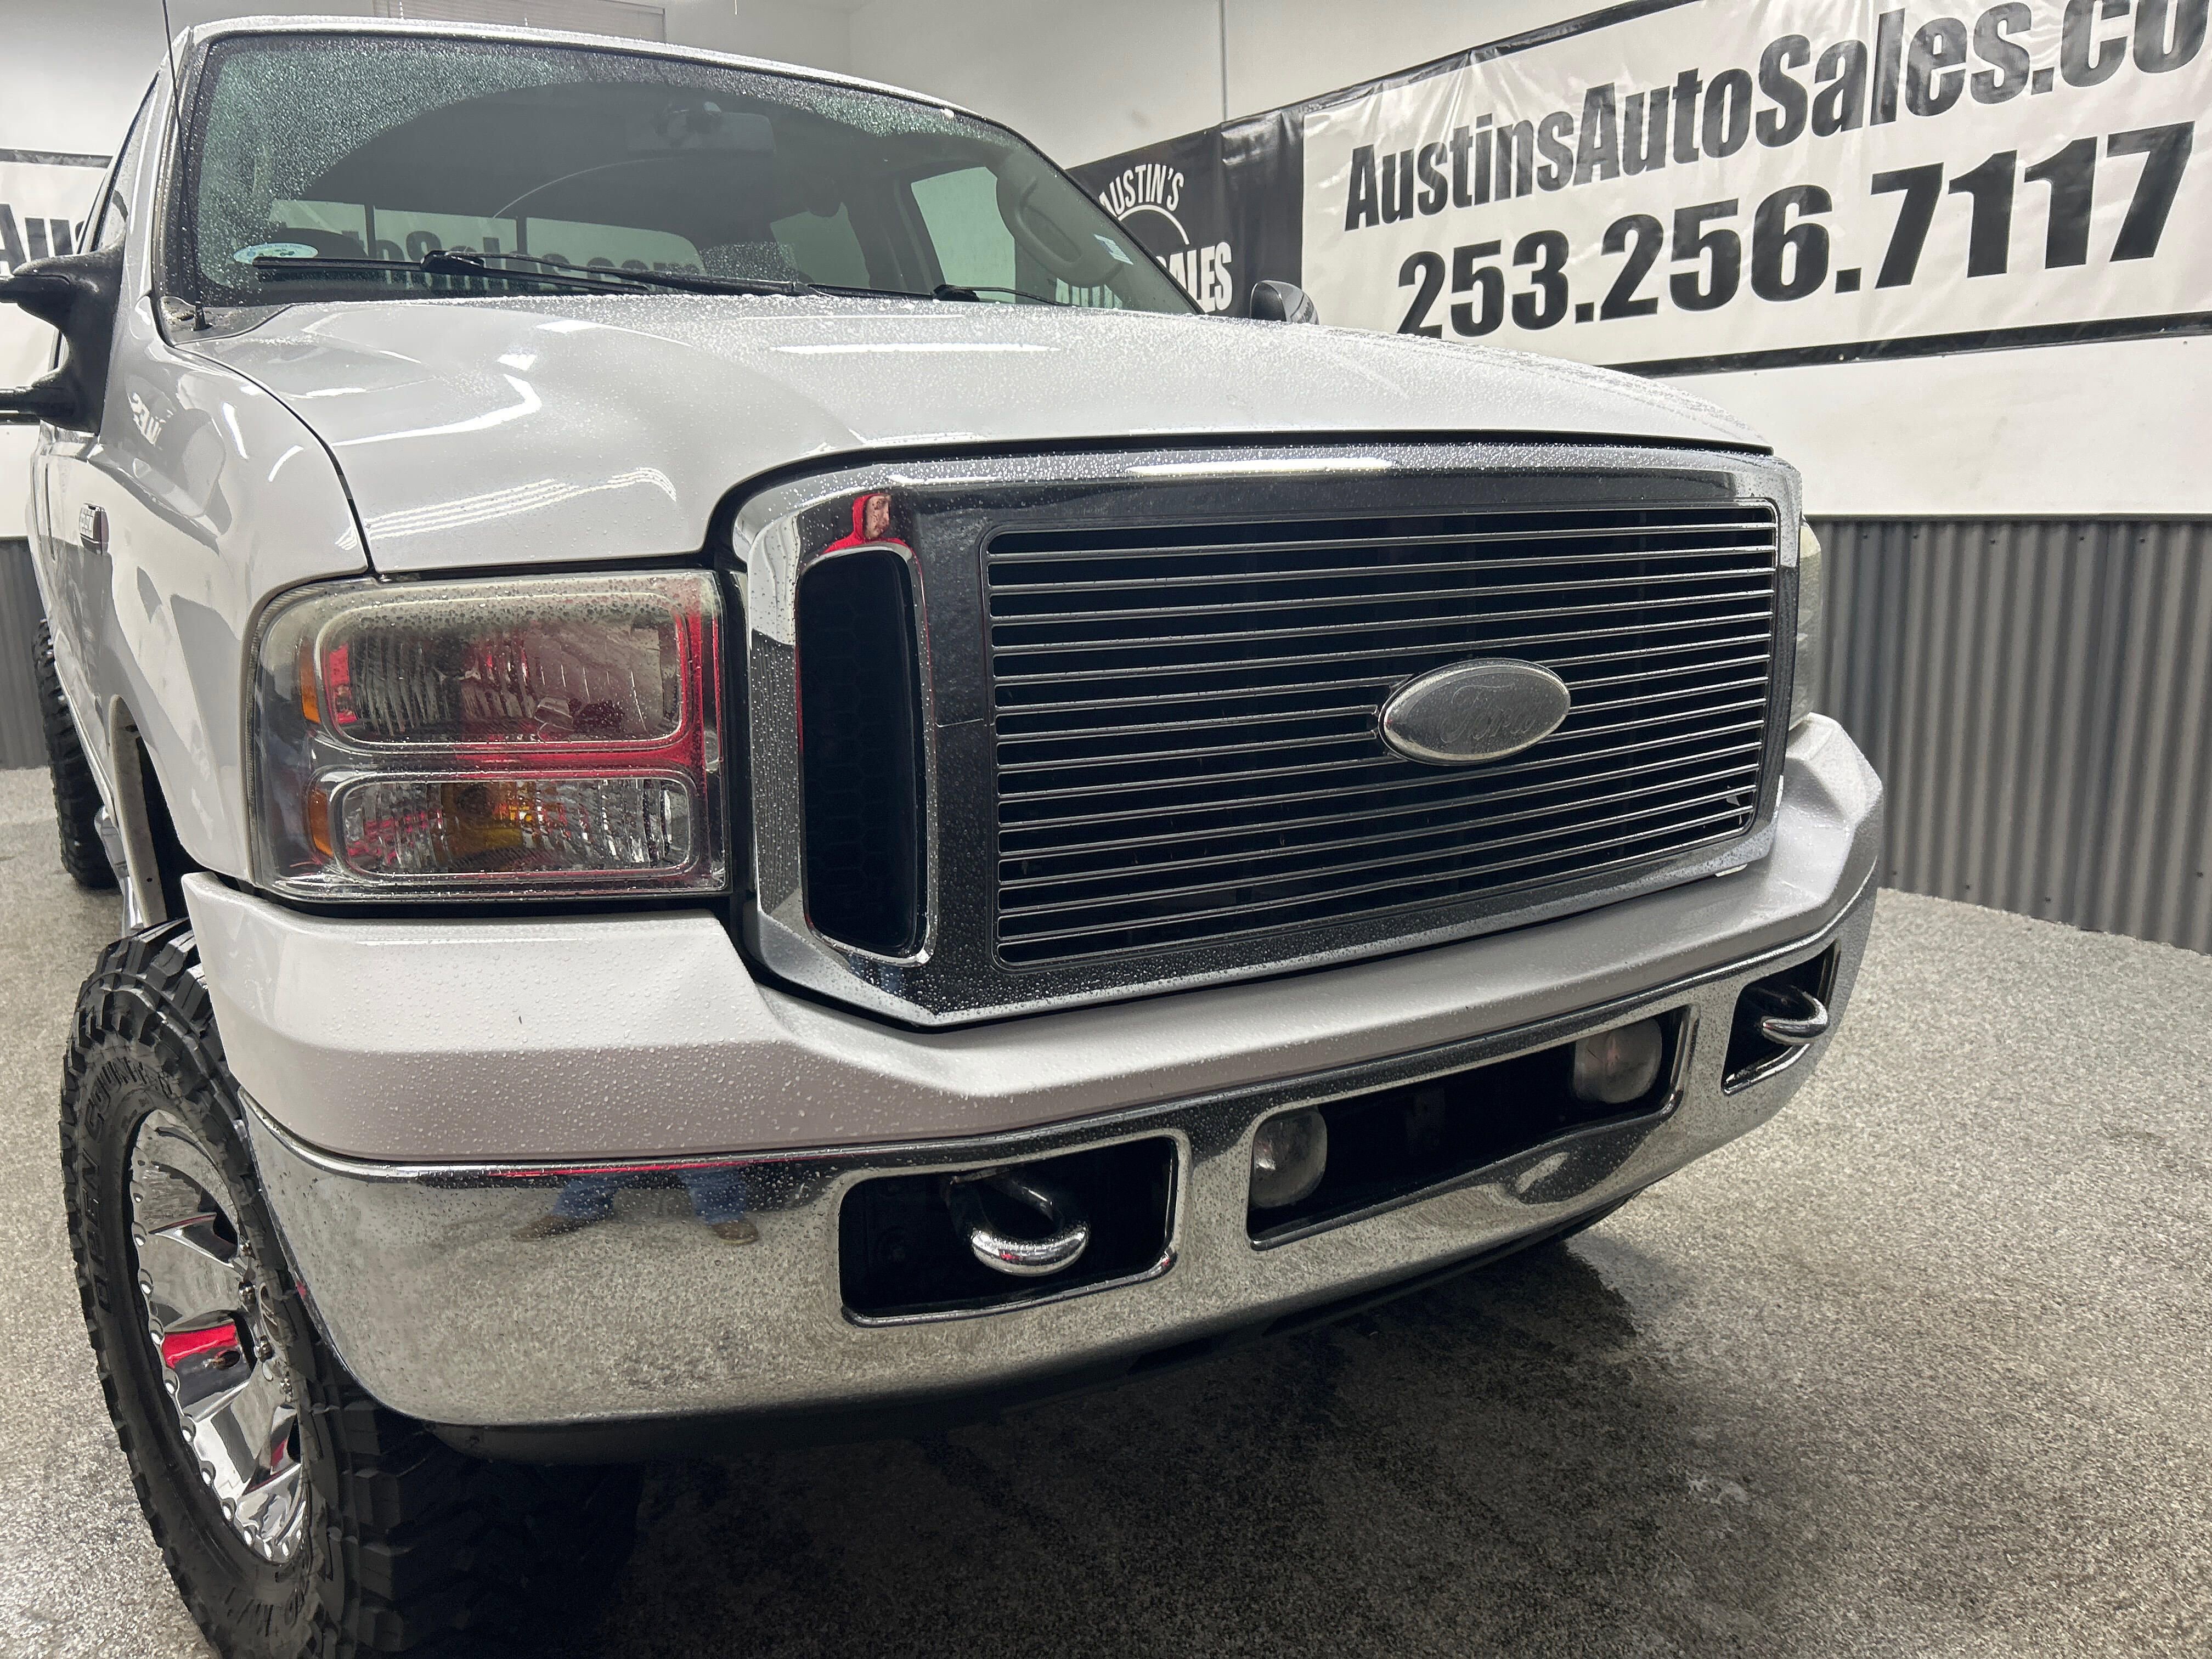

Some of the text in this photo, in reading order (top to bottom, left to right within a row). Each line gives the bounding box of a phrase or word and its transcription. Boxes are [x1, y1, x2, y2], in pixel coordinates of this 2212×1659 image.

[1344, 0, 2212, 231] AustinsAutoSales.co
[1099, 163, 1184, 217] AUSTIN'S
[1397, 121, 2196, 339] 253.256.7117
[1156, 242, 1232, 313] ALES
